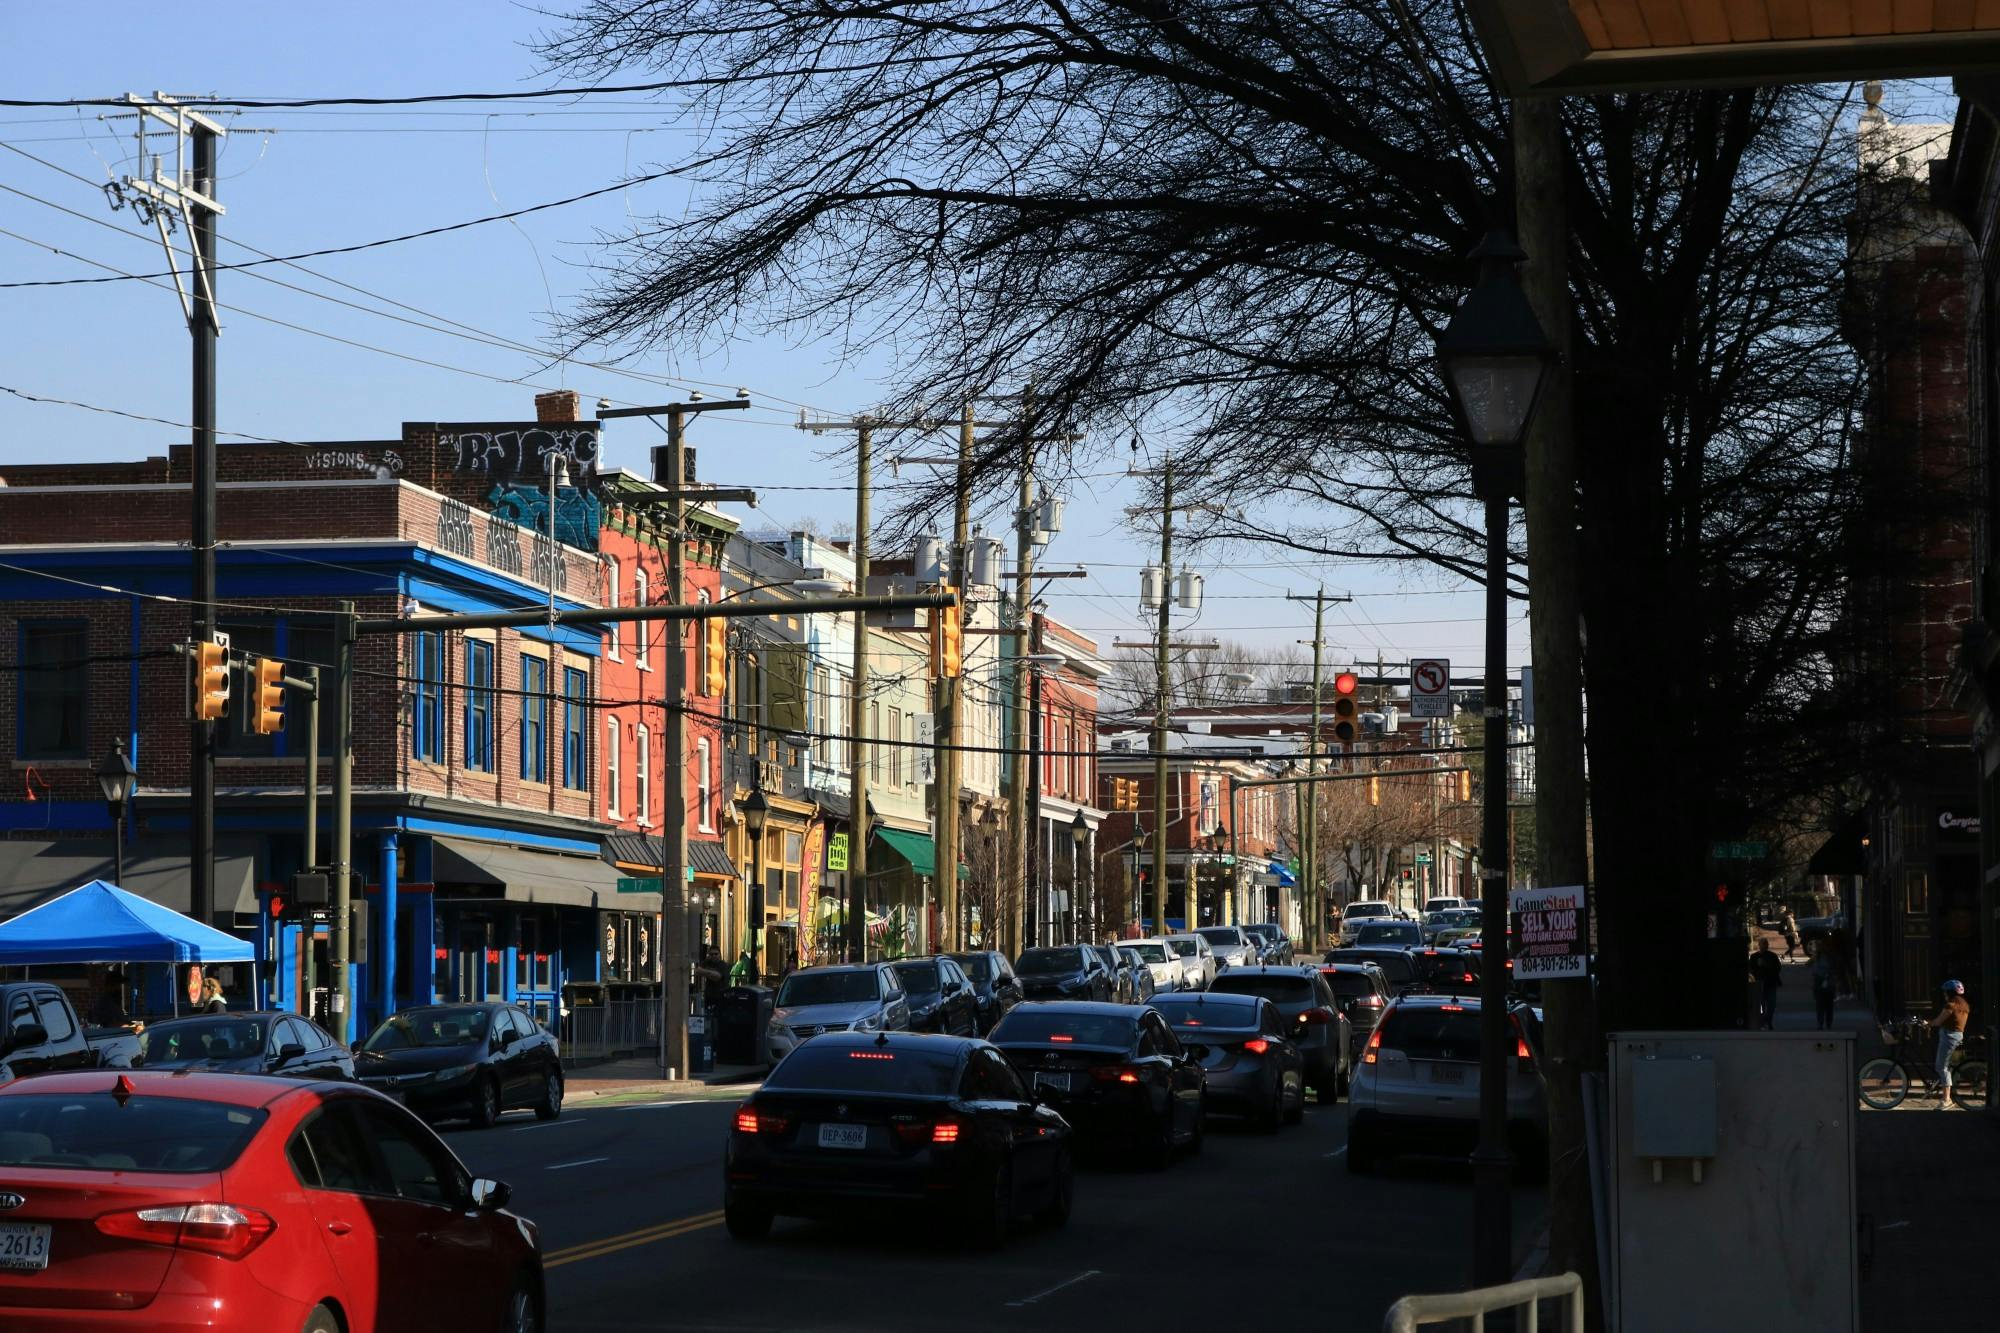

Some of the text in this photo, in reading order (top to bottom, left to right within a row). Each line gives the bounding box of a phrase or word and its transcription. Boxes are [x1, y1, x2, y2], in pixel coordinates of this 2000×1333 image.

[920, 721, 928, 777] GALLERY
[1516, 895, 1576, 911] GameStart
[1521, 910, 1576, 932] SELL YOUR
[1522, 929, 1577, 943] VIDEO GAME CONSOLE
